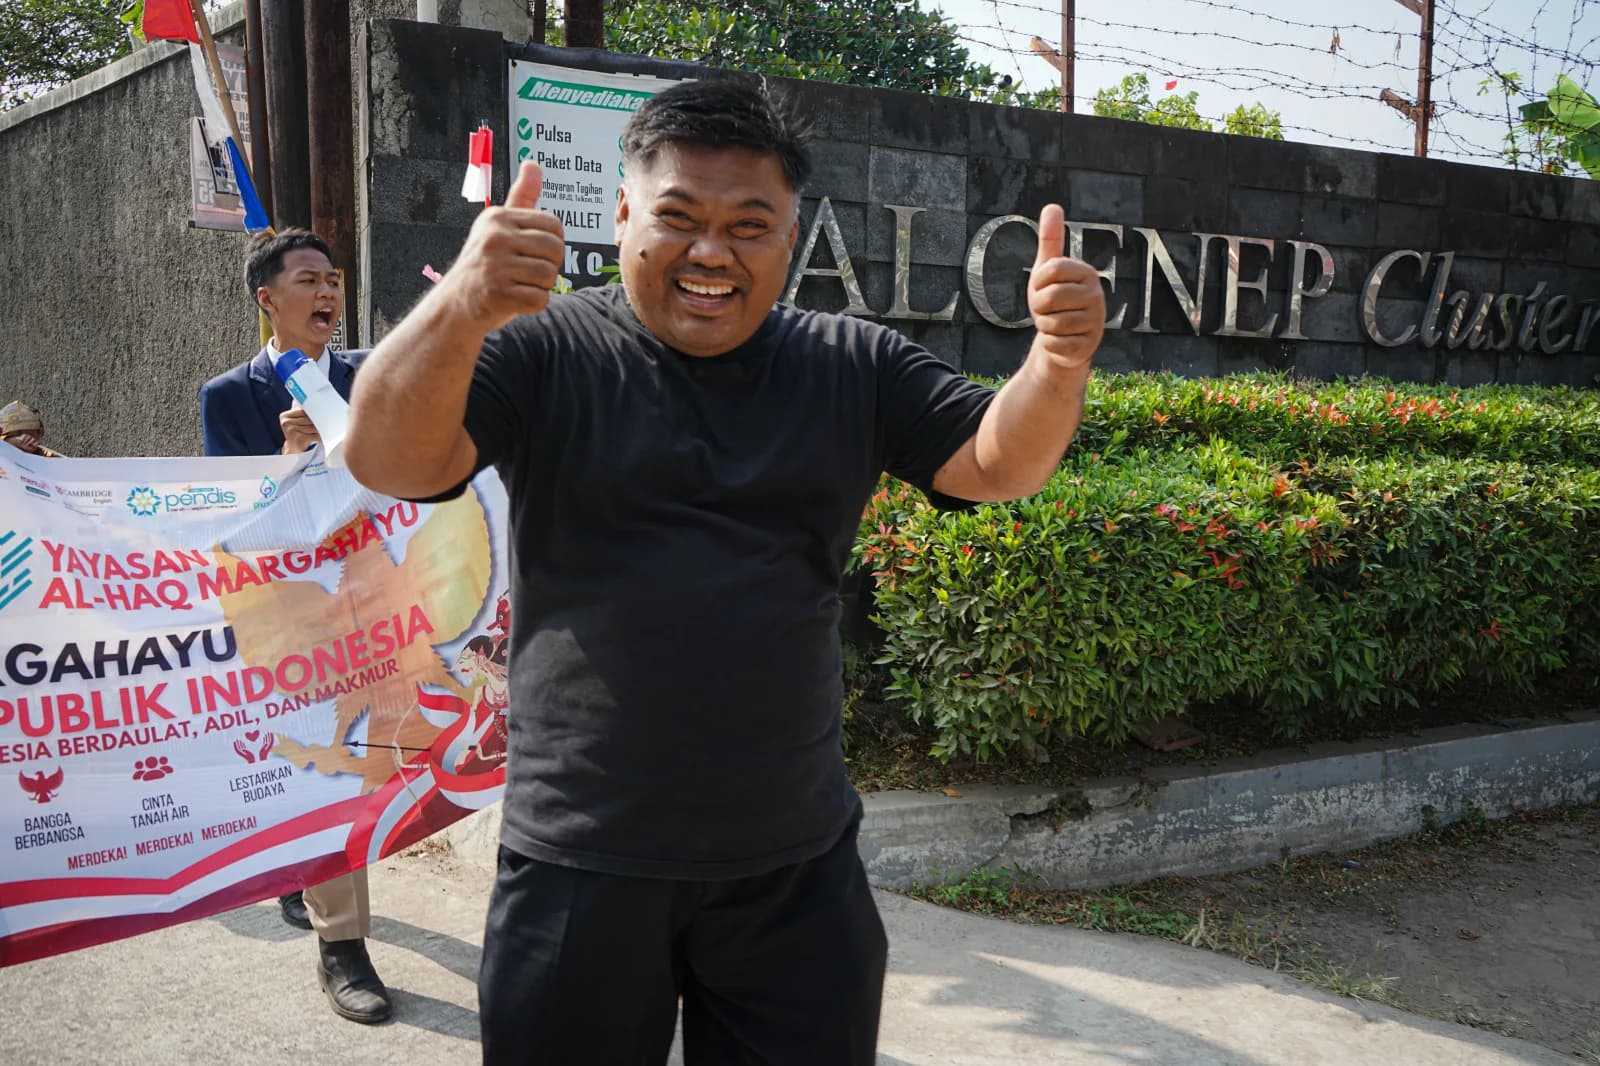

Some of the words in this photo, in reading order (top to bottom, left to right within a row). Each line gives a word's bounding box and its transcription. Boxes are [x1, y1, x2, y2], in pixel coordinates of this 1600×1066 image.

[528, 81, 650, 110] Menyediaka
[536, 123, 572, 143] Pulsa
[537, 151, 571, 170] Paket
[575, 155, 602, 173] Data
[576, 181, 603, 196] Tagihan
[541, 207, 602, 229] WALLET
[165, 487, 236, 512] pendis
[39, 577, 193, 611] AL-HAQ
[197, 502, 419, 600] MARGAHAYU
[41, 539, 210, 580] YAYASAN
[0, 626, 237, 686] GAHAYU
[187, 604, 434, 715] INDONESIA
[57, 721, 198, 757] BERDAULAT,
[204, 711, 260, 734] ADIL,
[265, 692, 310, 719] DAN
[316, 658, 399, 704] MAKMUR
[229, 765, 293, 792] LESTARIKAN
[142, 793, 174, 811] CINTA
[243, 782, 285, 803] BUDAYA
[24, 812, 72, 832] BANGGA
[131, 808, 169, 829] TANAH
[172, 805, 190, 821] AIR
[15, 827, 85, 850] BERBANGSA
[67, 846, 128, 870] MERDEKA!
[136, 831, 194, 856] MERDEKA!
[201, 816, 258, 840] MERDEKA!
